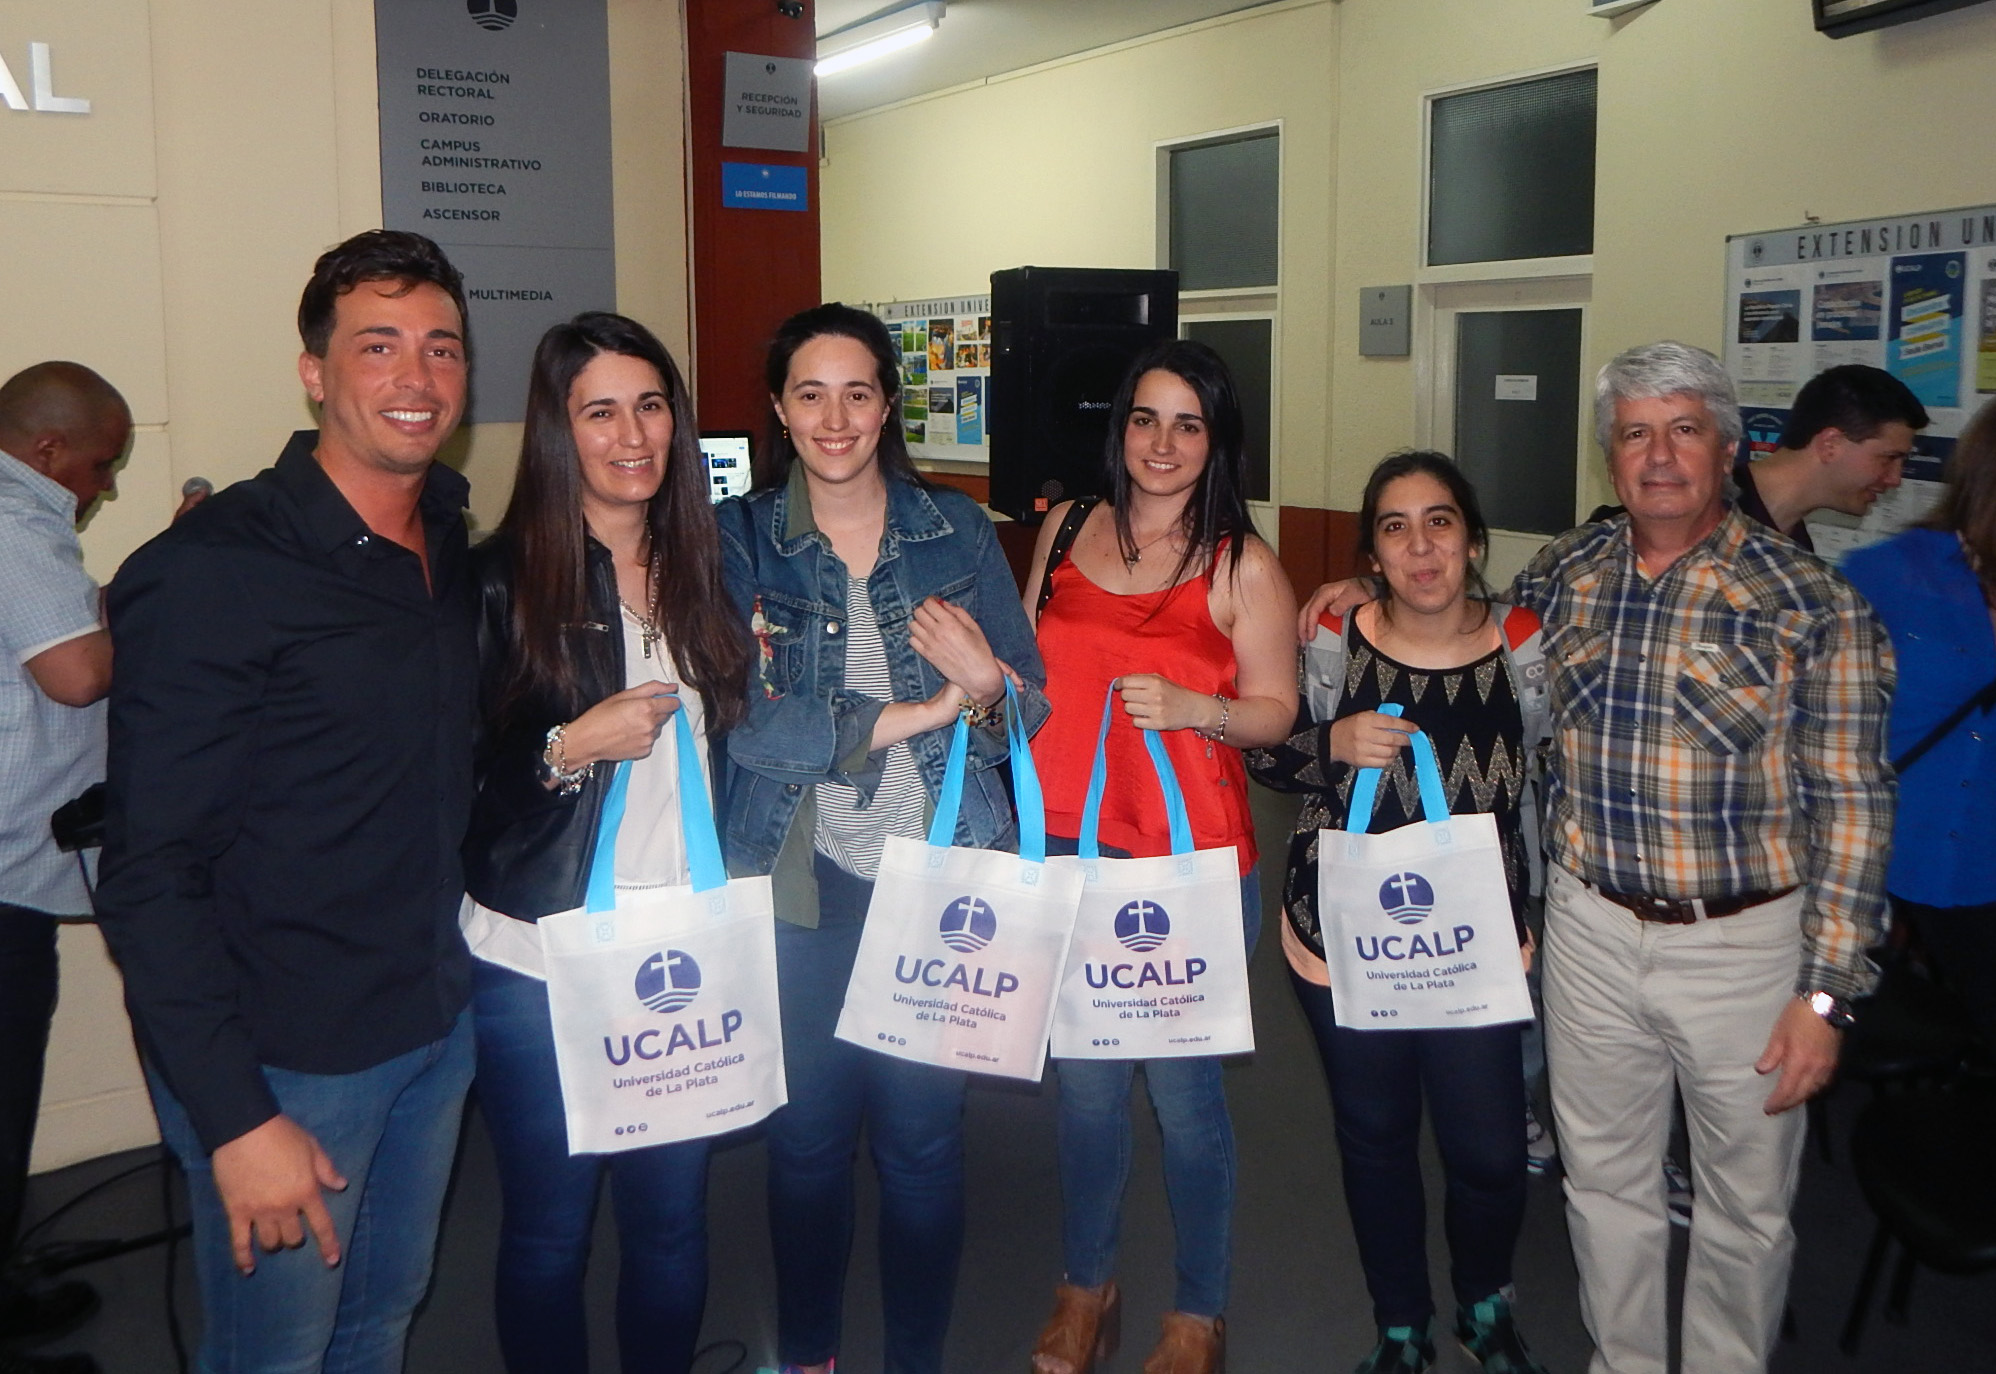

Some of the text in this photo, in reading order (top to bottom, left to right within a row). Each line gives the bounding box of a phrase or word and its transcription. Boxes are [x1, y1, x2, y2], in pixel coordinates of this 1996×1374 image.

[417, 68, 510, 84] DELEGACIÓN
[417, 85, 495, 99] RECTORAL
[741, 92, 798, 105] RECEPCIÓN
[419, 112, 495, 126] ORATORIO
[737, 105, 802, 118] Y SEGURIDAD
[421, 139, 481, 152] CAMPUS
[421, 156, 541, 171] ADMINISTRATIVO
[421, 181, 506, 195] BIBLIOTECA
[735, 190, 797, 200] LO ESTAMOS FILMANDO
[423, 208, 500, 221] ASCENSOR
[1797, 221, 1941, 259] EXTENSION
[469, 289, 553, 301] MULTIMEDIA
[904, 302, 955, 317] EXTENSION
[1355, 924, 1475, 961] UCALP
[895, 955, 1019, 999] UCALP
[1085, 957, 1207, 989] UCALP
[1366, 961, 1477, 980] Universidad Católica
[1393, 979, 1455, 991] de La Plata
[893, 992, 1007, 1021] Universidad Católica
[1092, 993, 1205, 1008] Universidad Católica
[1119, 1009, 1181, 1019] de La Plata
[1445, 1003, 1488, 1016] ucalp.edu.ar
[916, 1011, 978, 1029] de La Plata
[604, 1009, 743, 1066] UCALP
[1168, 1035, 1211, 1044] ucalp.edu.ar
[955, 1049, 999, 1063] ucalp.edu.ar
[613, 1053, 745, 1089] Universidad Católica
[645, 1075, 719, 1097] de La Plata
[706, 1100, 755, 1119] ucalp.edu.ar
